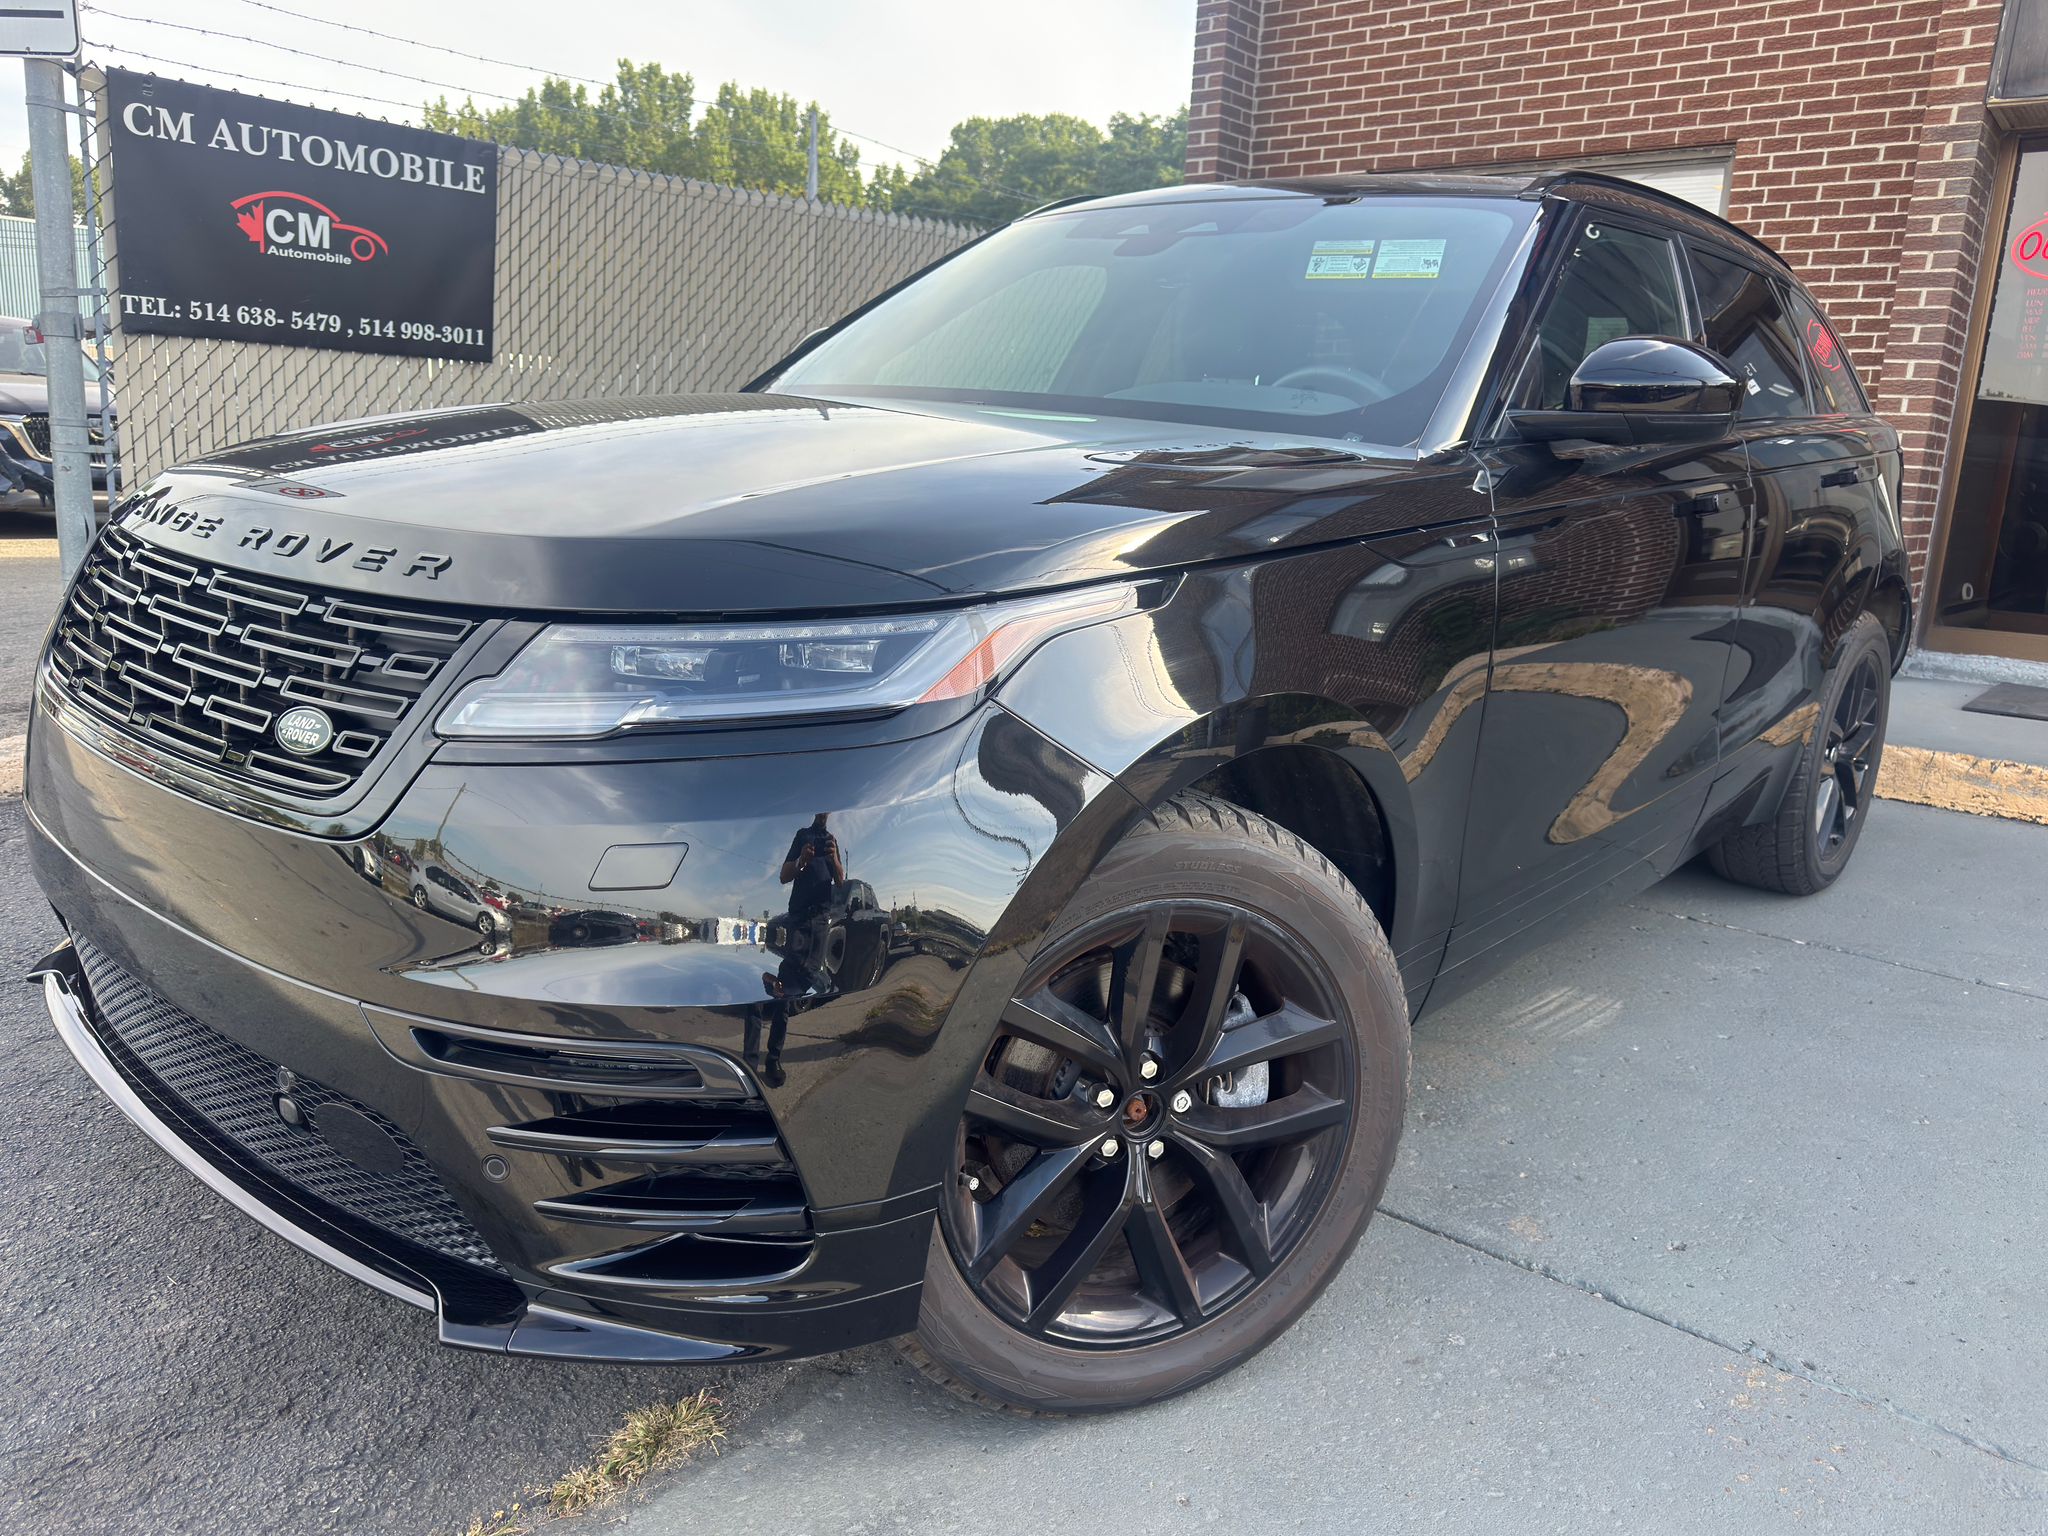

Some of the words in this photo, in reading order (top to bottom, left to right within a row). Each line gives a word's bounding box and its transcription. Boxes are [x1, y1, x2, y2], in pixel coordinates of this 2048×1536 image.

[122, 102, 196, 145] CM
[207, 118, 486, 194] AUTOMOBILE
[265, 208, 331, 249] CM
[267, 245, 352, 265] Automobile
[120, 294, 181, 319] TEL:
[189, 301, 231, 323] 514
[290, 311, 342, 333] 5479
[359, 317, 396, 338] 514
[400, 322, 485, 346] 998-3011
[237, 524, 453, 580] ROVER
[284, 727, 320, 746] ROVER
[287, 714, 316, 729] LAND
[1173, 860, 1242, 874] STUDLESS
